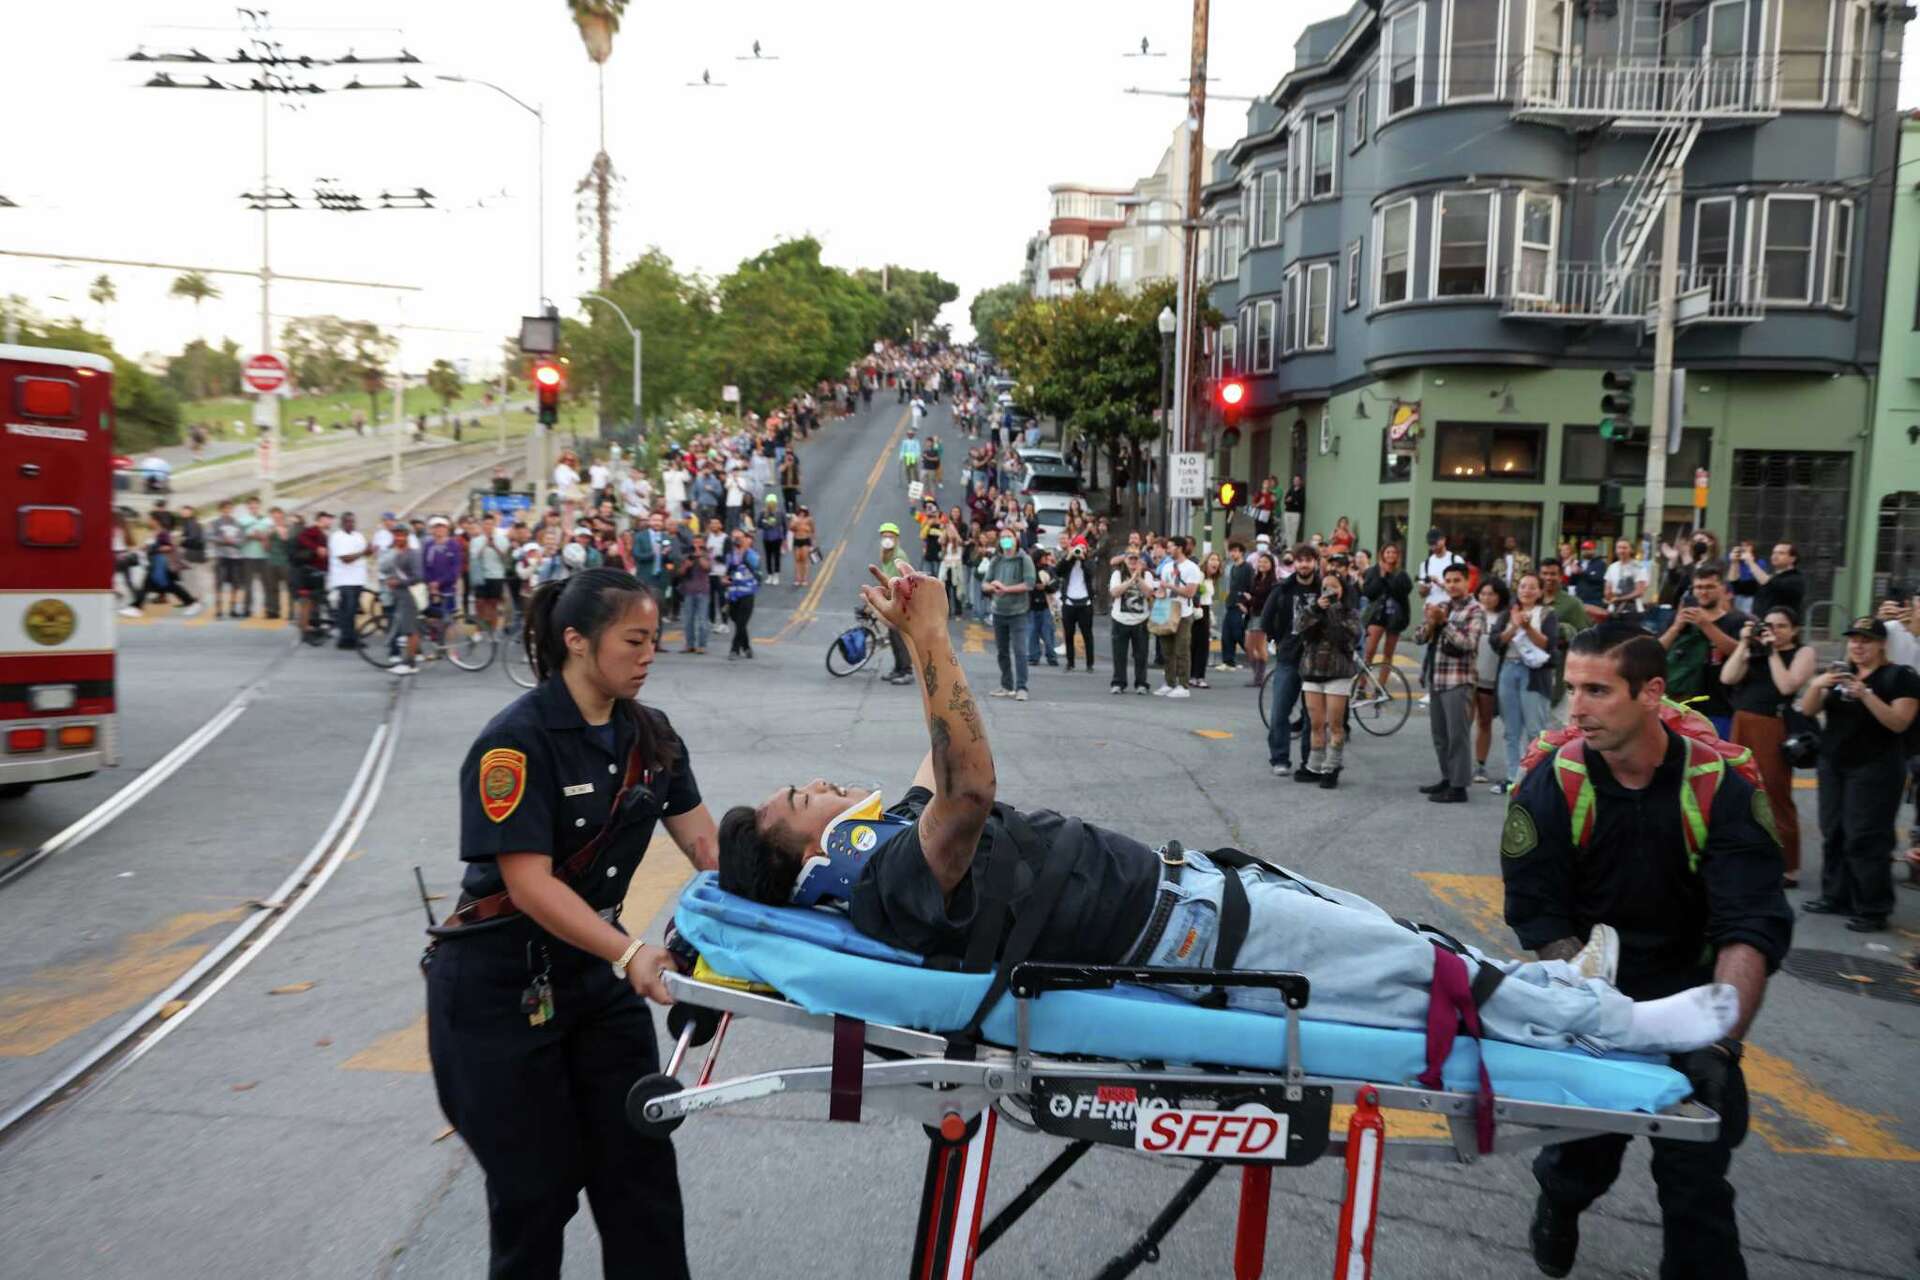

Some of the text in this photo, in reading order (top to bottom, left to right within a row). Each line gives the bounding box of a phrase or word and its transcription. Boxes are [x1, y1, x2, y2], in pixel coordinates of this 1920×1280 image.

[1179, 457, 1196, 465] NO
[1178, 468, 1199, 476] TURN
[1142, 1112, 1279, 1154] SFFD
